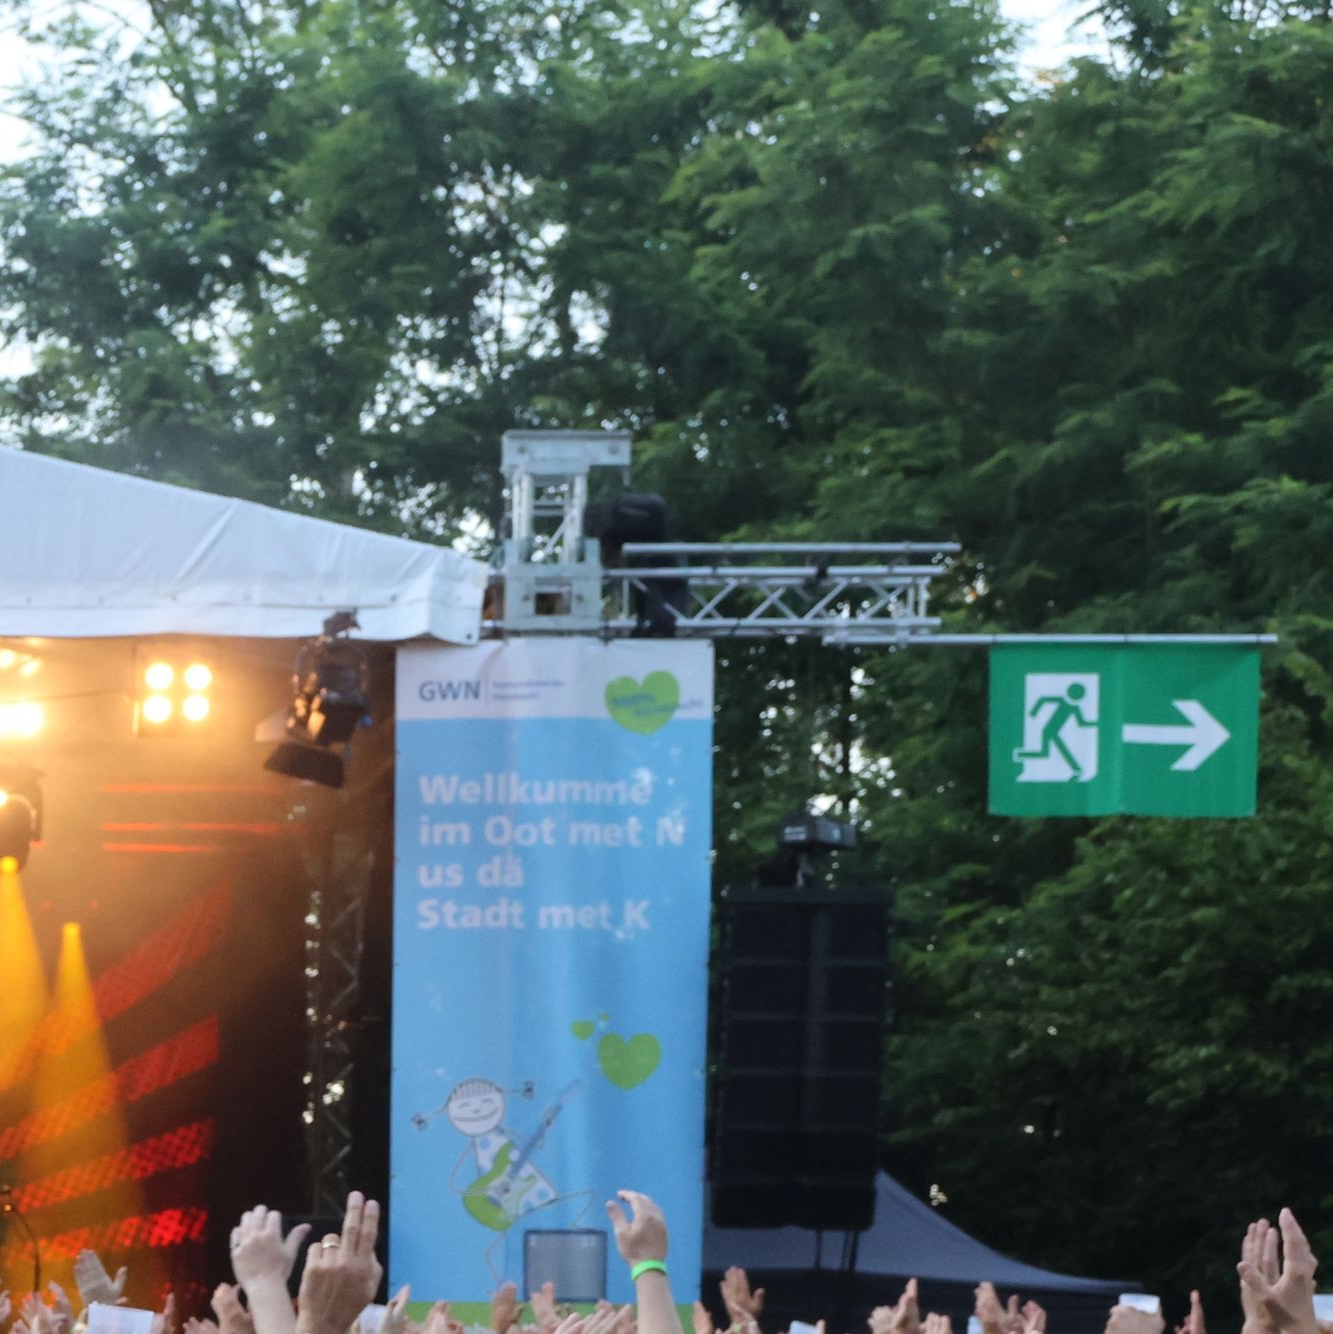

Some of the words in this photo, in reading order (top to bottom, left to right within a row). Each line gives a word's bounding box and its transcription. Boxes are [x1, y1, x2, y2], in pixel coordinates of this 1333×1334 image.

[419, 680, 481, 701] GWN
[422, 773, 652, 804] Wellkumme
[423, 817, 470, 845] im
[488, 817, 555, 845] Oot
[572, 818, 642, 845] met
[659, 818, 685, 845] N
[421, 864, 463, 886] us
[420, 899, 524, 928] Stadt
[541, 901, 612, 928] met
[627, 901, 651, 928] K
